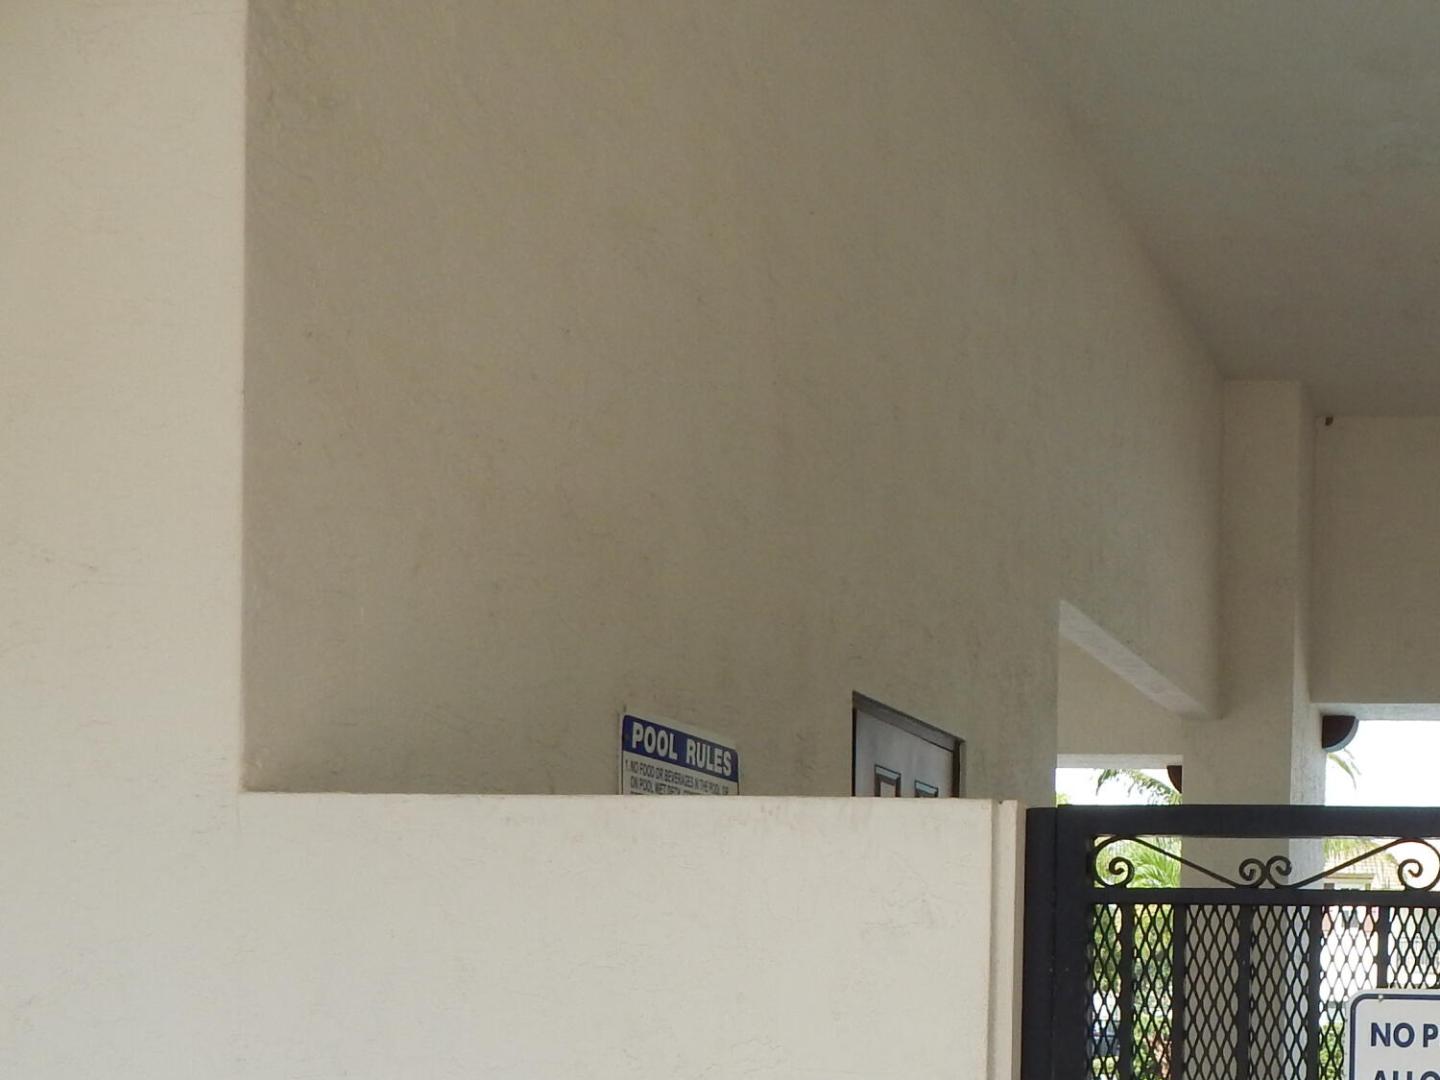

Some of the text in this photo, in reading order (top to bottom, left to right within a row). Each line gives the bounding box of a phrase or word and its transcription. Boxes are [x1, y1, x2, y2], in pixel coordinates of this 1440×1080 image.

[632, 722, 731, 776] POOL RULES
[1371, 1023, 1415, 1047] NO
